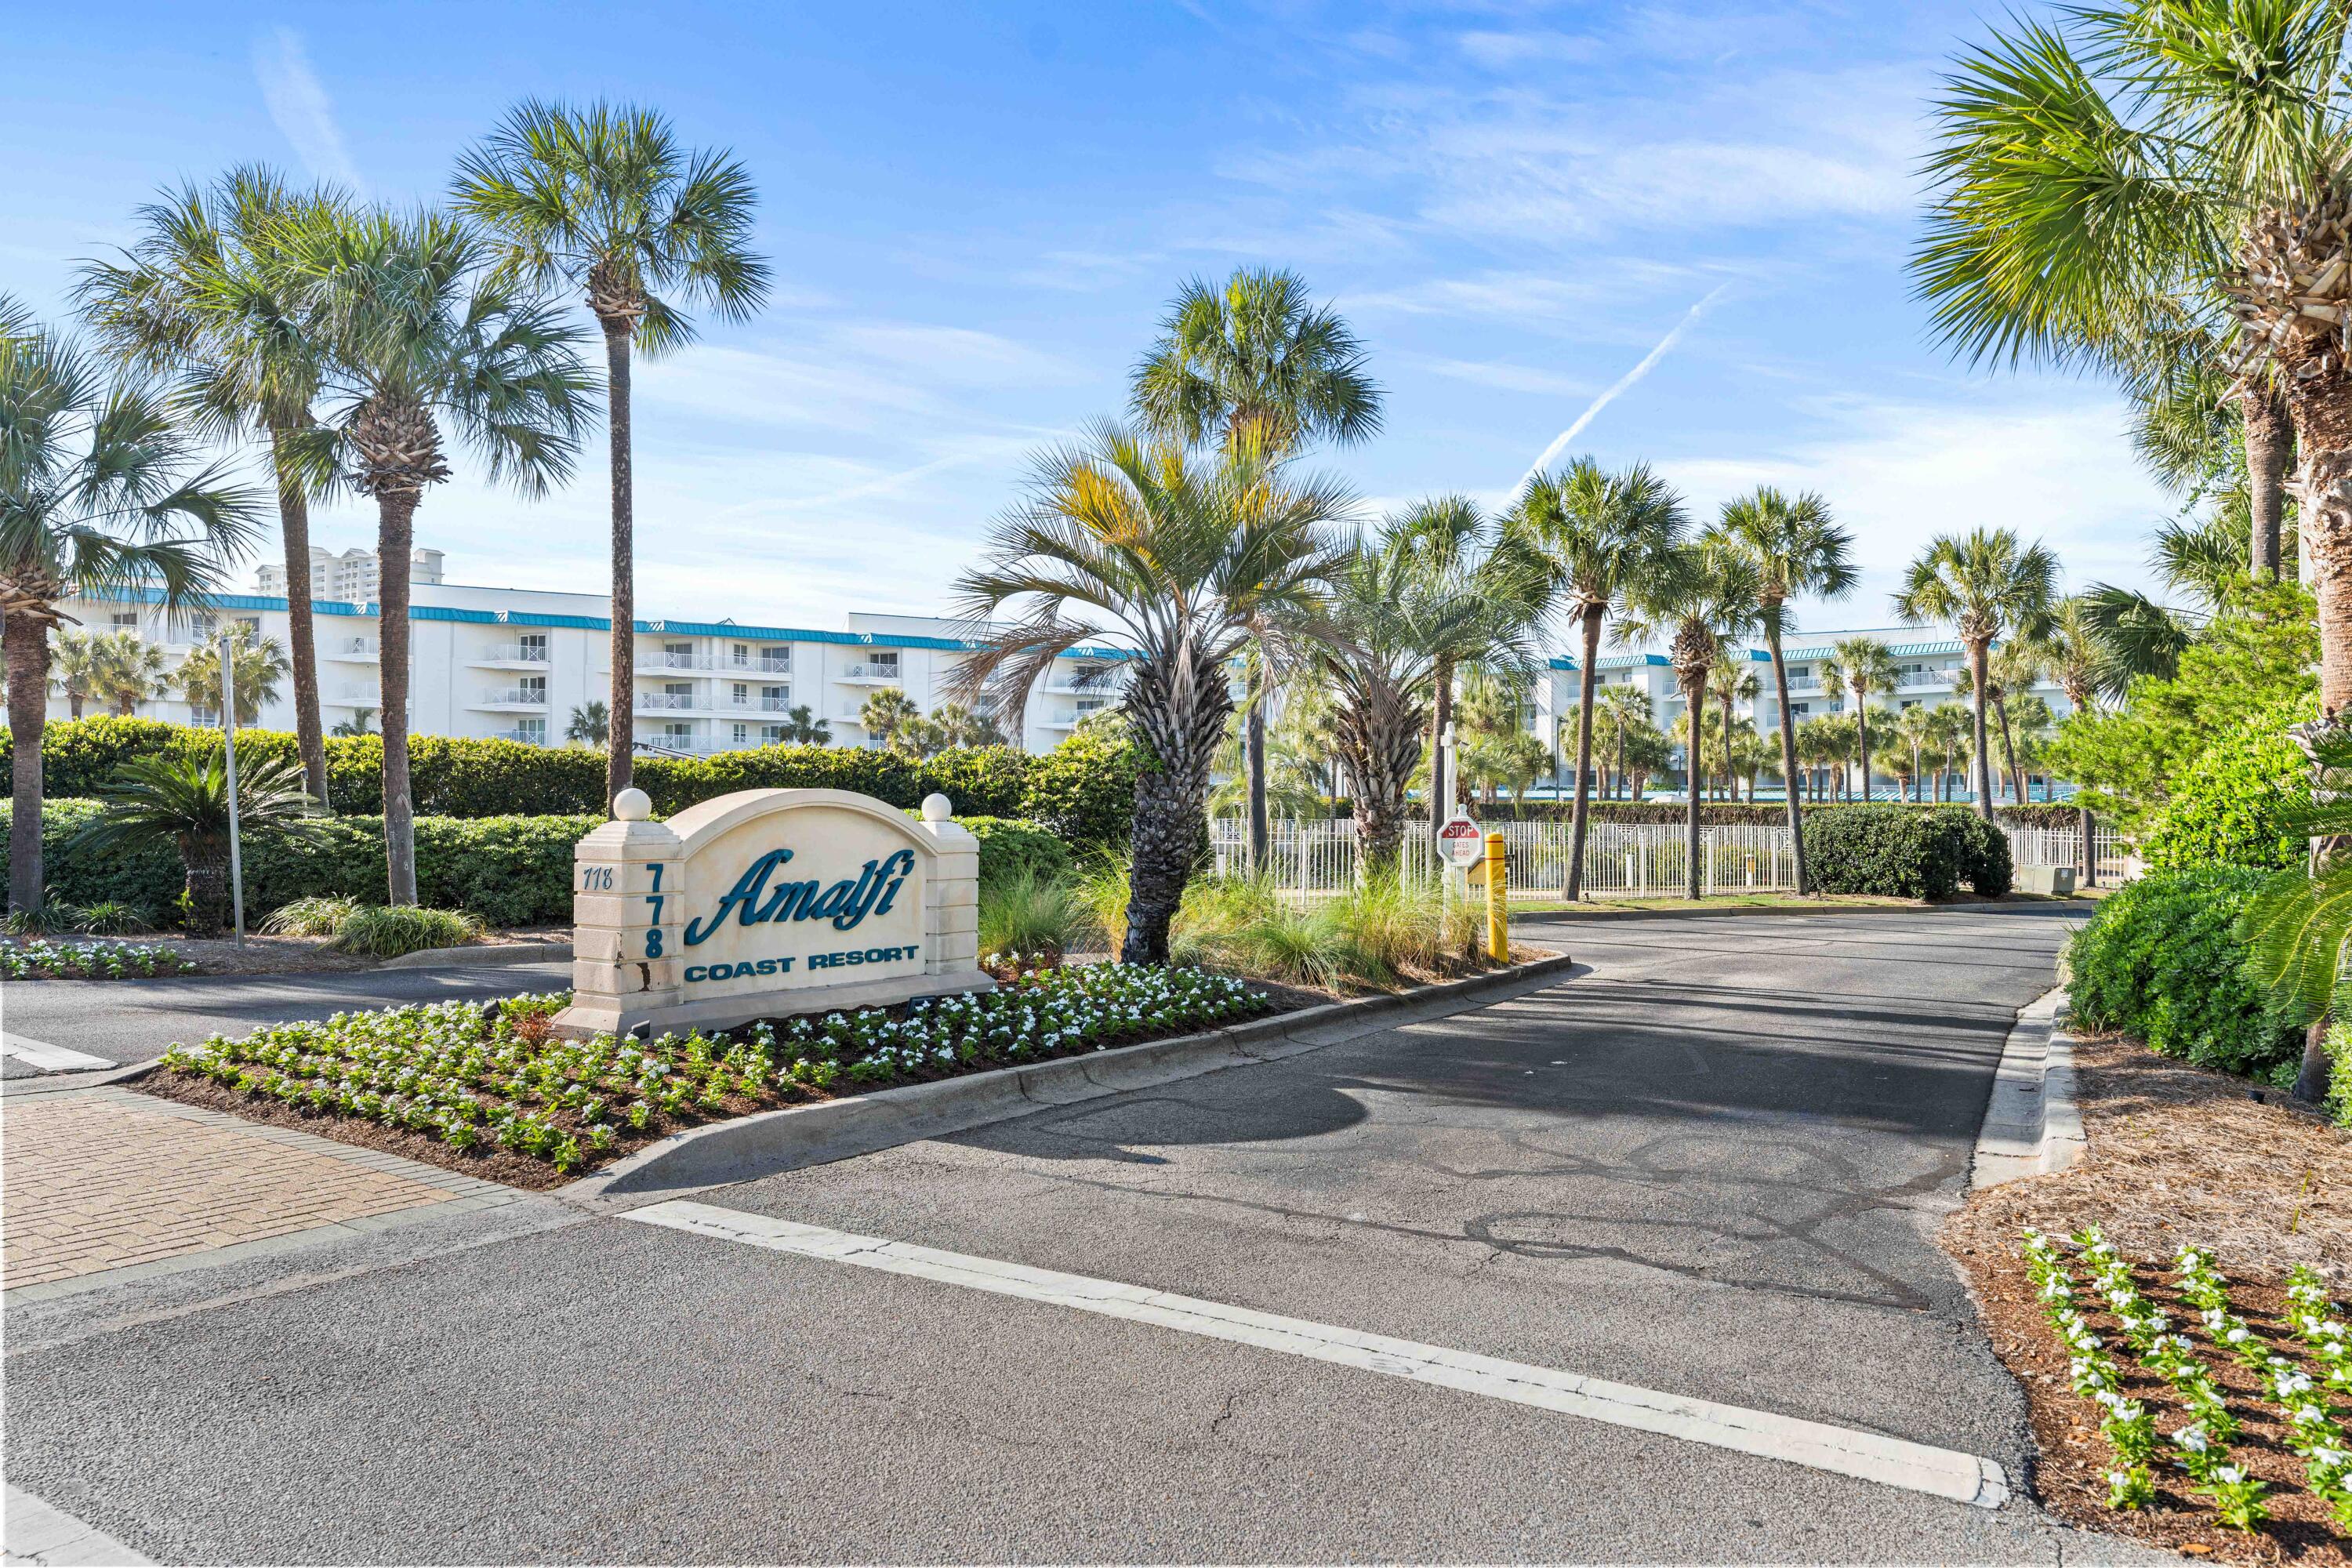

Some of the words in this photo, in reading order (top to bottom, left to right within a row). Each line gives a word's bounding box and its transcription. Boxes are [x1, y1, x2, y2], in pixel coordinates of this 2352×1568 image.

[1448, 825, 1474, 837] STOP
[684, 848, 915, 946] Amalfi
[684, 956, 796, 982] COAST
[808, 945, 920, 971] RESORT
